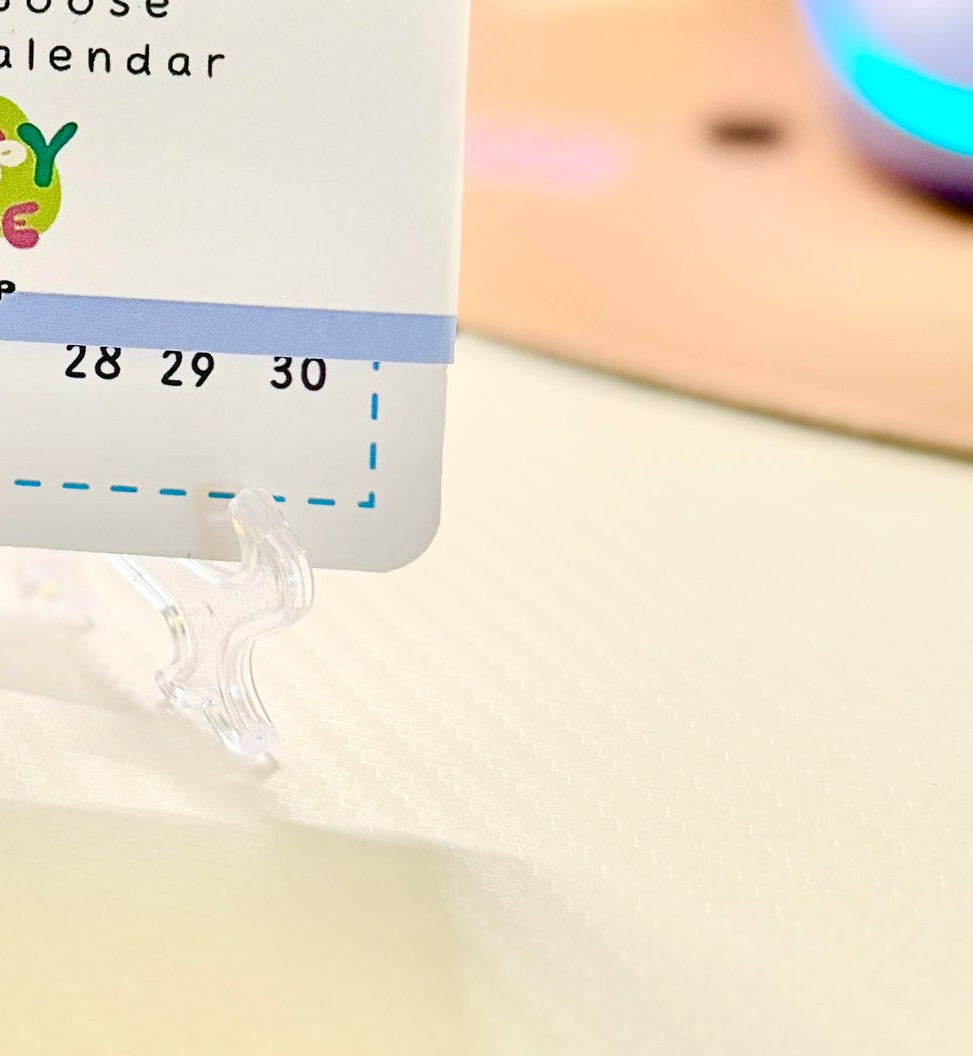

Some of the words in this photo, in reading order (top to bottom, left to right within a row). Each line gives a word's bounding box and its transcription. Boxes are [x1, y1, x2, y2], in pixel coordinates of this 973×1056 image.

[64, 344, 122, 380] 28
[160, 350, 215, 388] 29
[270, 356, 327, 392] 30
